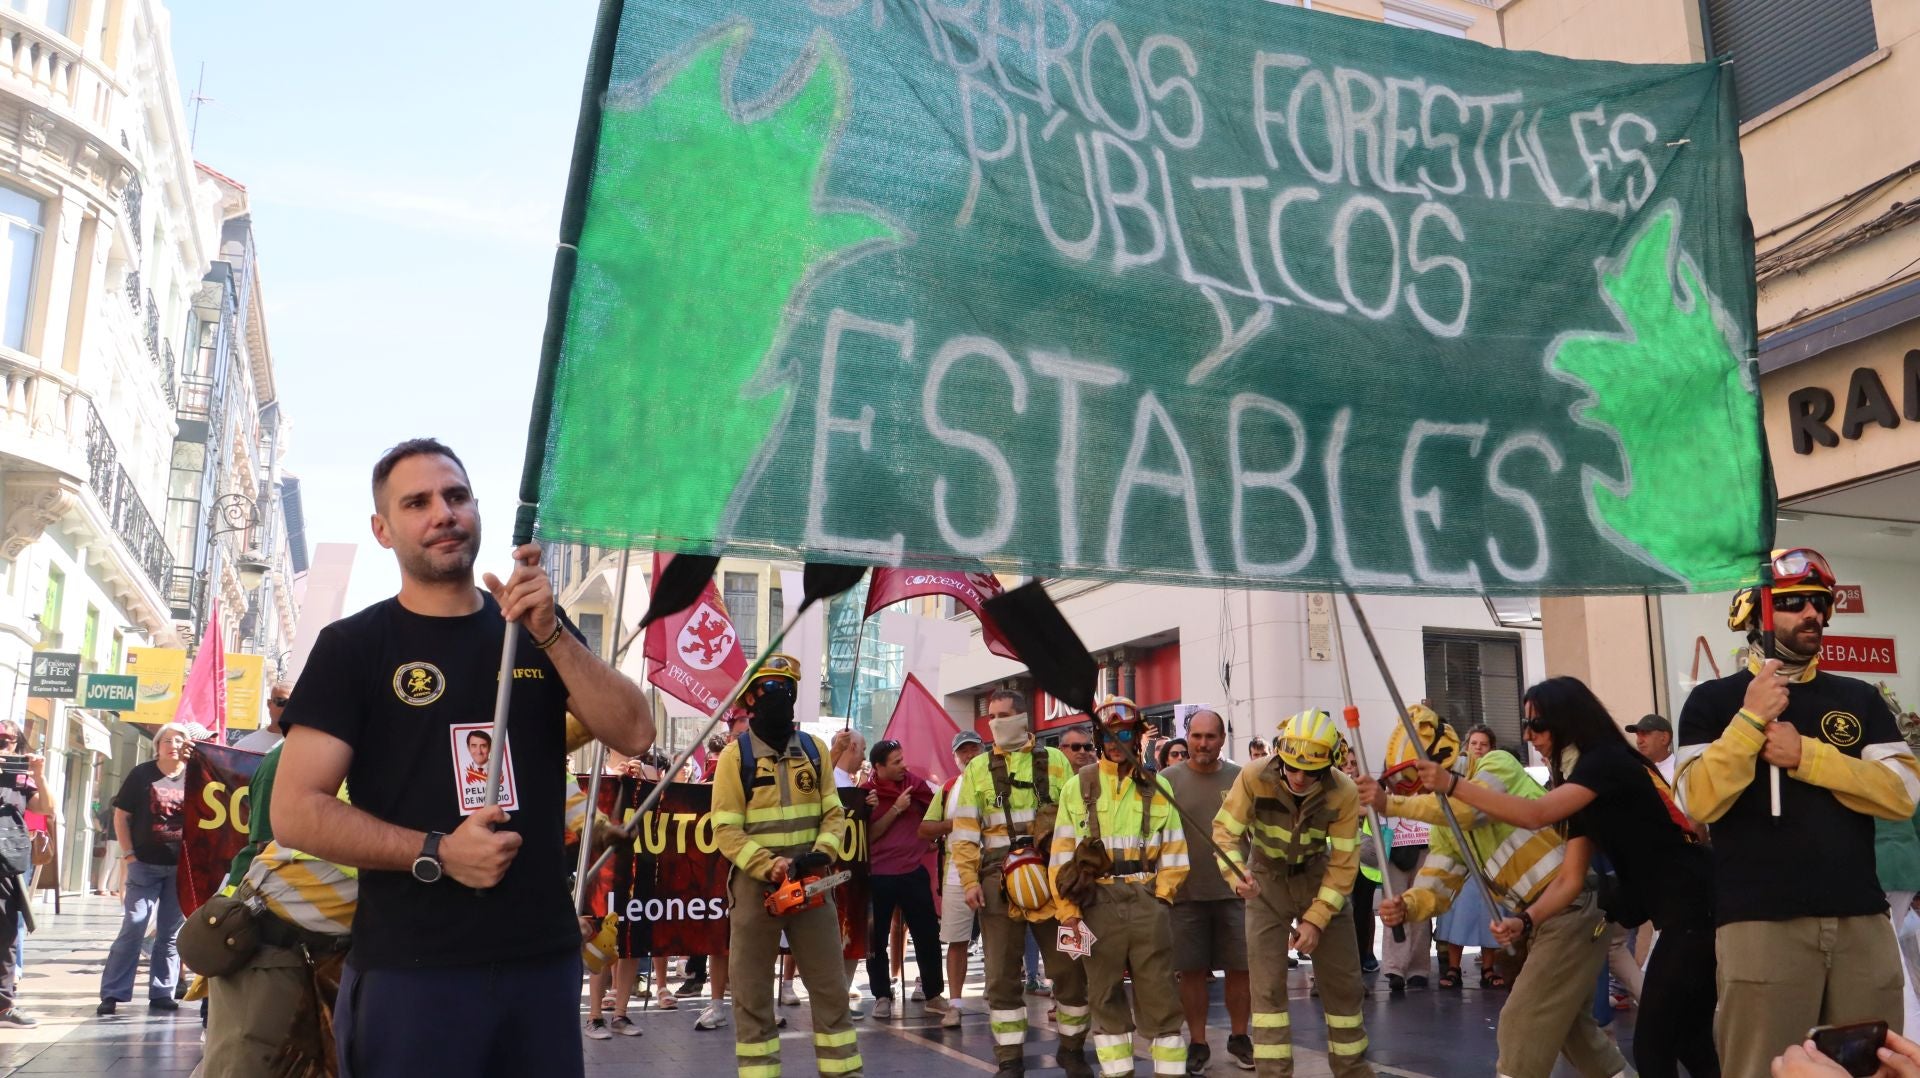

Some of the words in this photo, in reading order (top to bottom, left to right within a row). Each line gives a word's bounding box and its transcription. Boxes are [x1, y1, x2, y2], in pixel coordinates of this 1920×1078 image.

[1253, 51, 1657, 217] FORESTALES
[803, 310, 1565, 592] ESTABLES
[1818, 645, 1890, 663] REBAJAS
[50, 667, 70, 676] FER
[88, 685, 134, 700] JOYERIA
[607, 891, 730, 922] Leones
